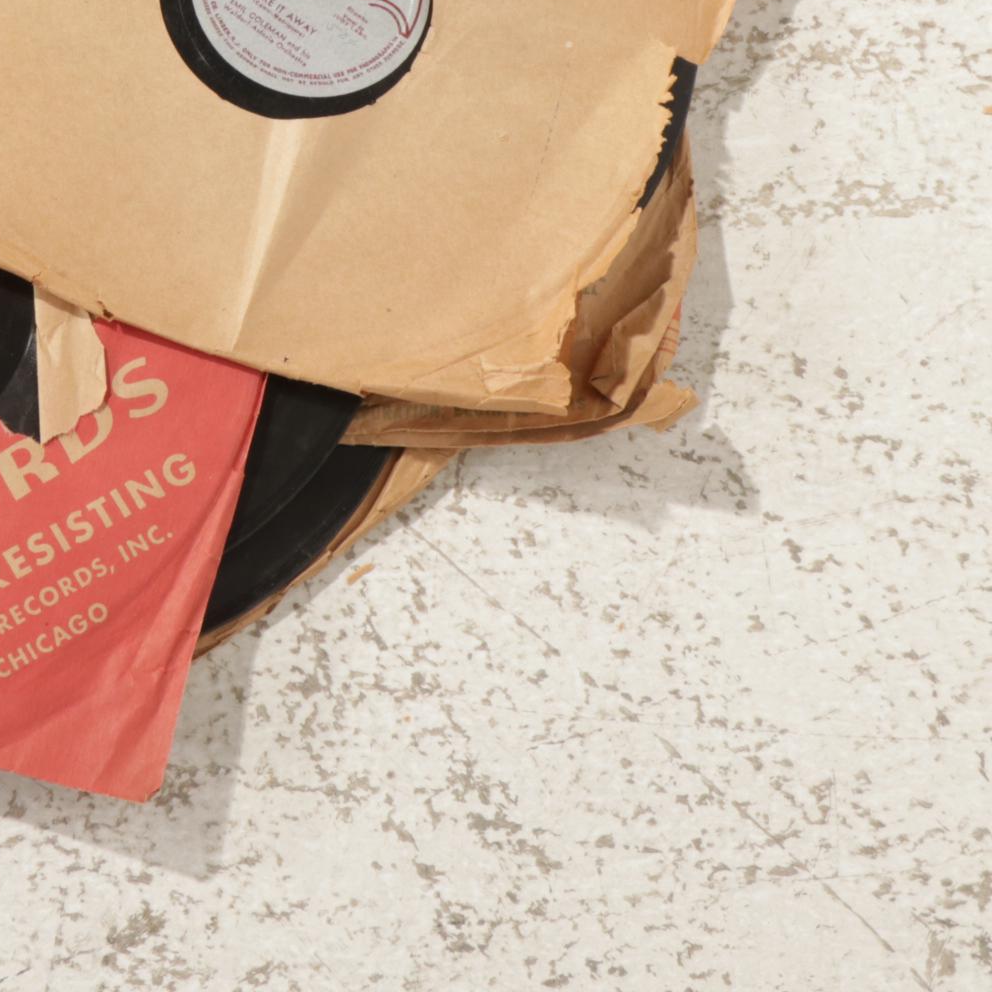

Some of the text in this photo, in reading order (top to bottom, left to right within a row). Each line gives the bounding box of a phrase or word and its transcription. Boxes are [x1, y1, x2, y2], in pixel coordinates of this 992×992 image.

[248, 9, 287, 41] COLEMAN
[275, 2, 286, 12] IT
[286, 11, 318, 36] AWAY
[118, 524, 174, 563] INC.
